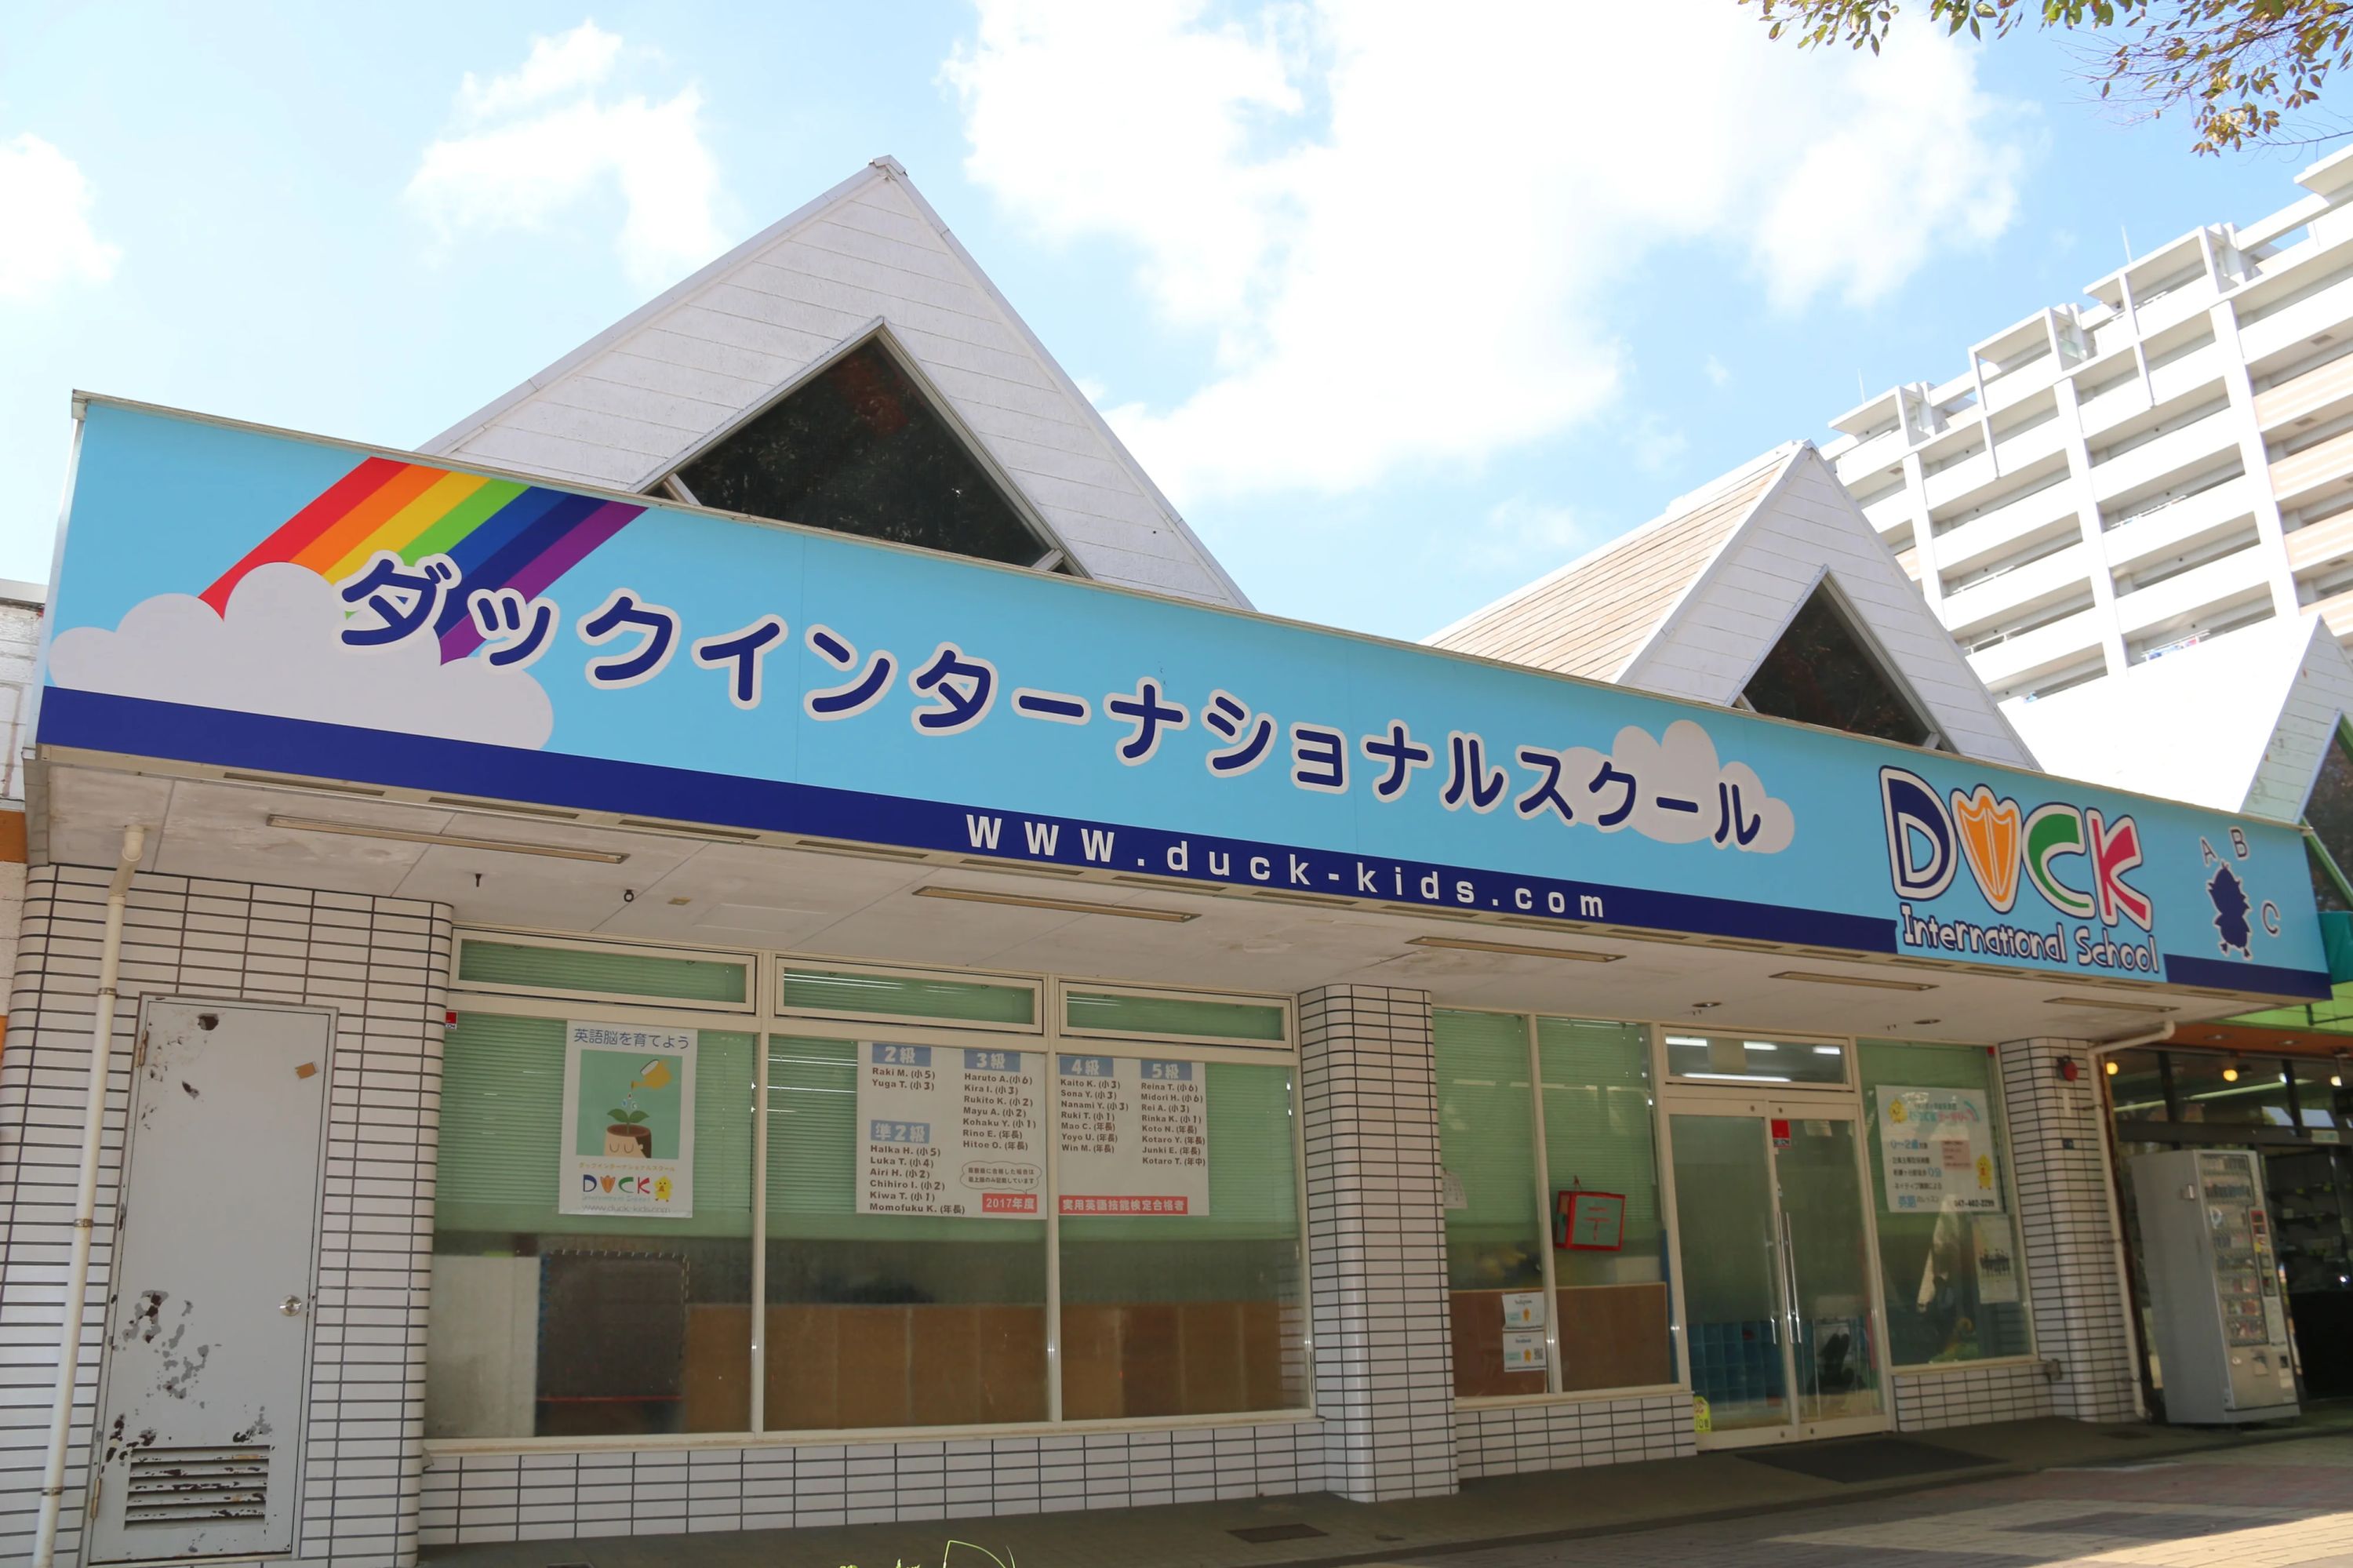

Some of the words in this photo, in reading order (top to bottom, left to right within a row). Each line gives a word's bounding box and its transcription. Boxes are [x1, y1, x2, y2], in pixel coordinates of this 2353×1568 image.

[337, 551, 1763, 849] ダックインターナショナルスクール
[1879, 765, 2153, 931] DUCK
[2228, 826, 2249, 861] B
[2262, 900, 2282, 937] C
[1899, 903, 2068, 962] International
[2074, 924, 2159, 973] School
[573, 1028, 689, 1050] 英語脳を育てよう
[885, 1046, 916, 1064] 2級
[976, 1053, 1006, 1069] 3級
[1071, 1059, 1100, 1075] 4級
[1151, 1063, 1179, 1079] 5級
[872, 1079, 896, 1089] Yuga
[965, 1073, 996, 1082] Haruto
[1060, 1079, 1084, 1087] Kaito
[964, 1095, 995, 1104] Rukito
[963, 1107, 987, 1116] Mayu
[962, 1118, 999, 1126] Kohaku
[875, 1122, 926, 1143] 準2級
[1061, 1133, 1082, 1142] Yoyo
[870, 1180, 907, 1188] Chihiro
[870, 1203, 923, 1212] Momofuku
[986, 1198, 1035, 1210] 2017年度
[1062, 1199, 1185, 1211] 実用英語技能検定合格者
